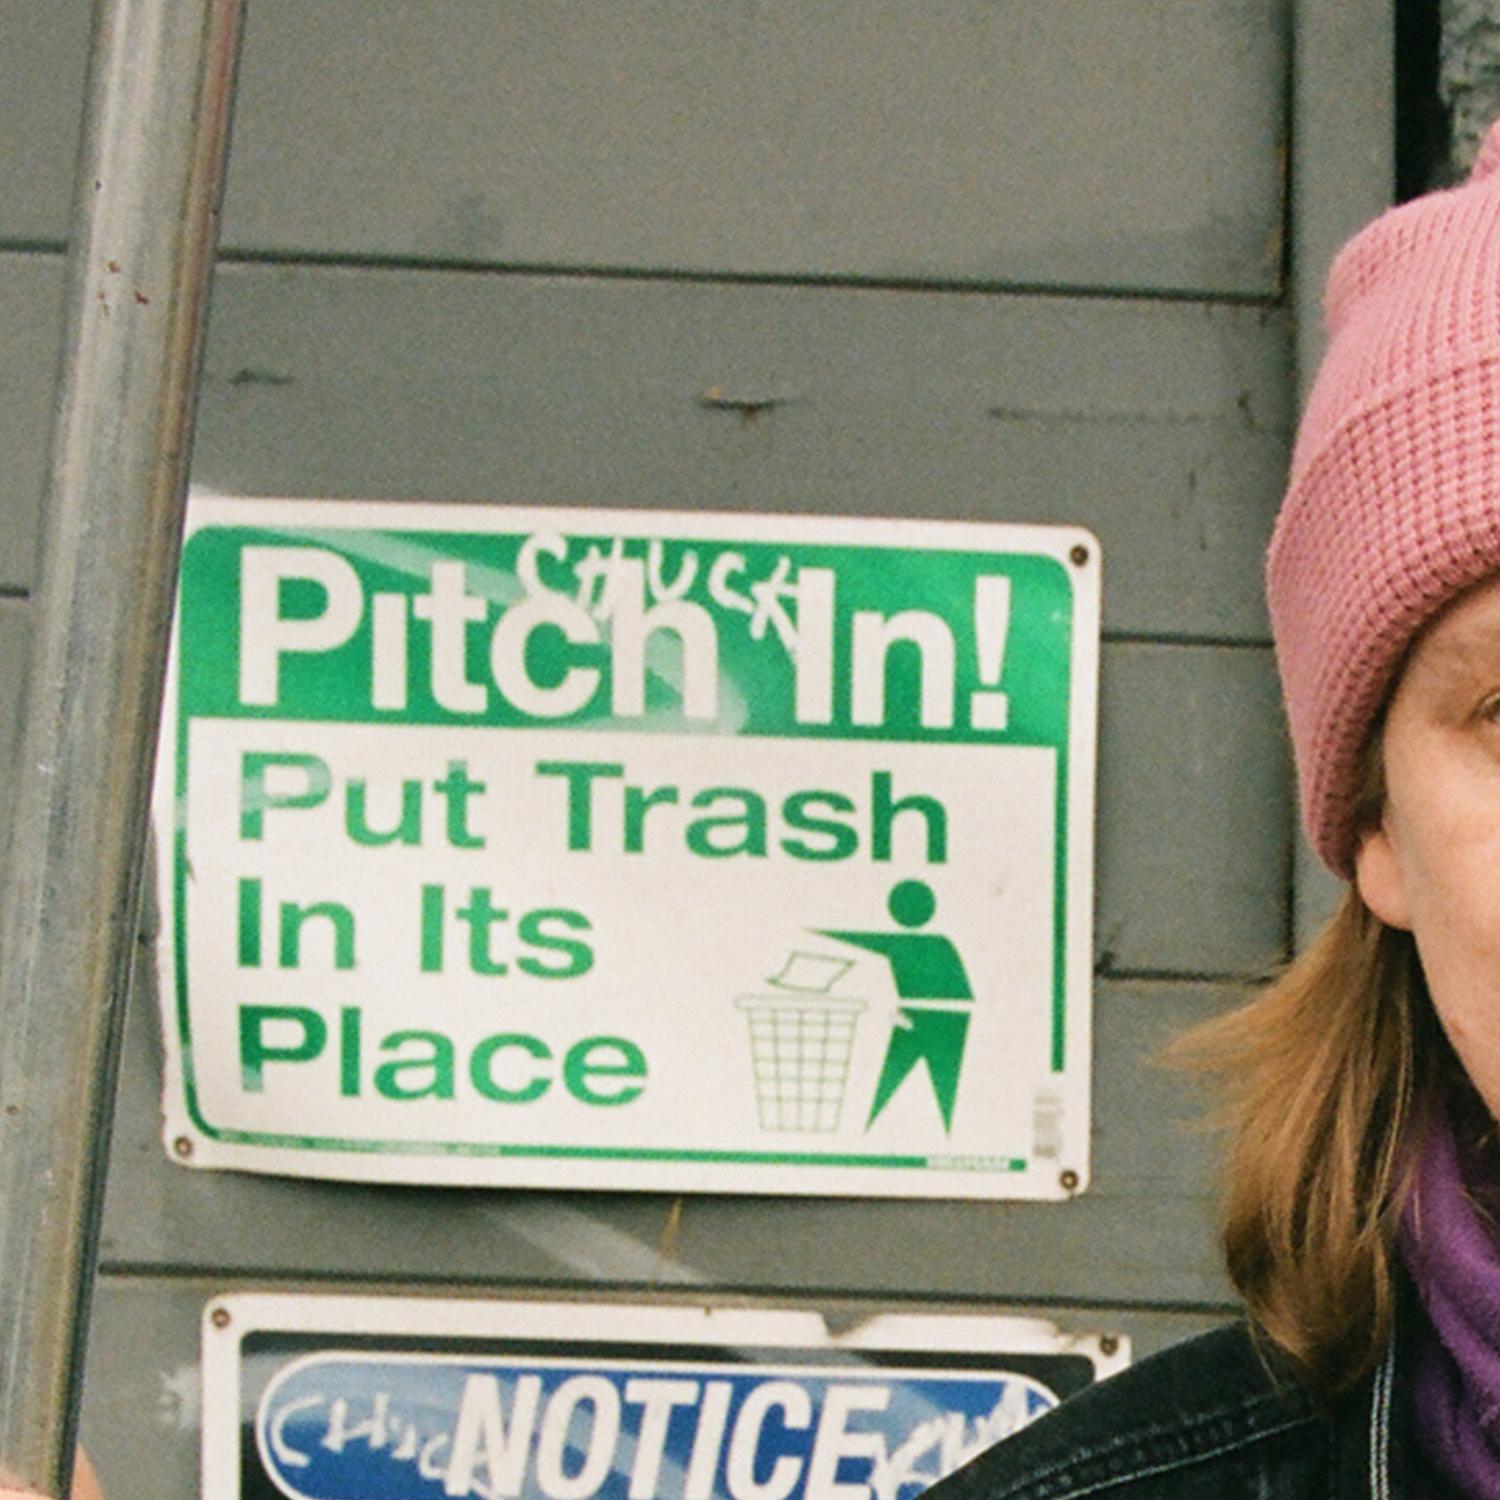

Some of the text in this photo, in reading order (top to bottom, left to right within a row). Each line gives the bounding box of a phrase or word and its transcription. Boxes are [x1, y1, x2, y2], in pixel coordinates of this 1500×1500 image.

[240, 548, 1010, 729] Pitch In!
[238, 750, 949, 865] Put Trash
[235, 877, 595, 981] In Its
[237, 1003, 649, 1108] Place
